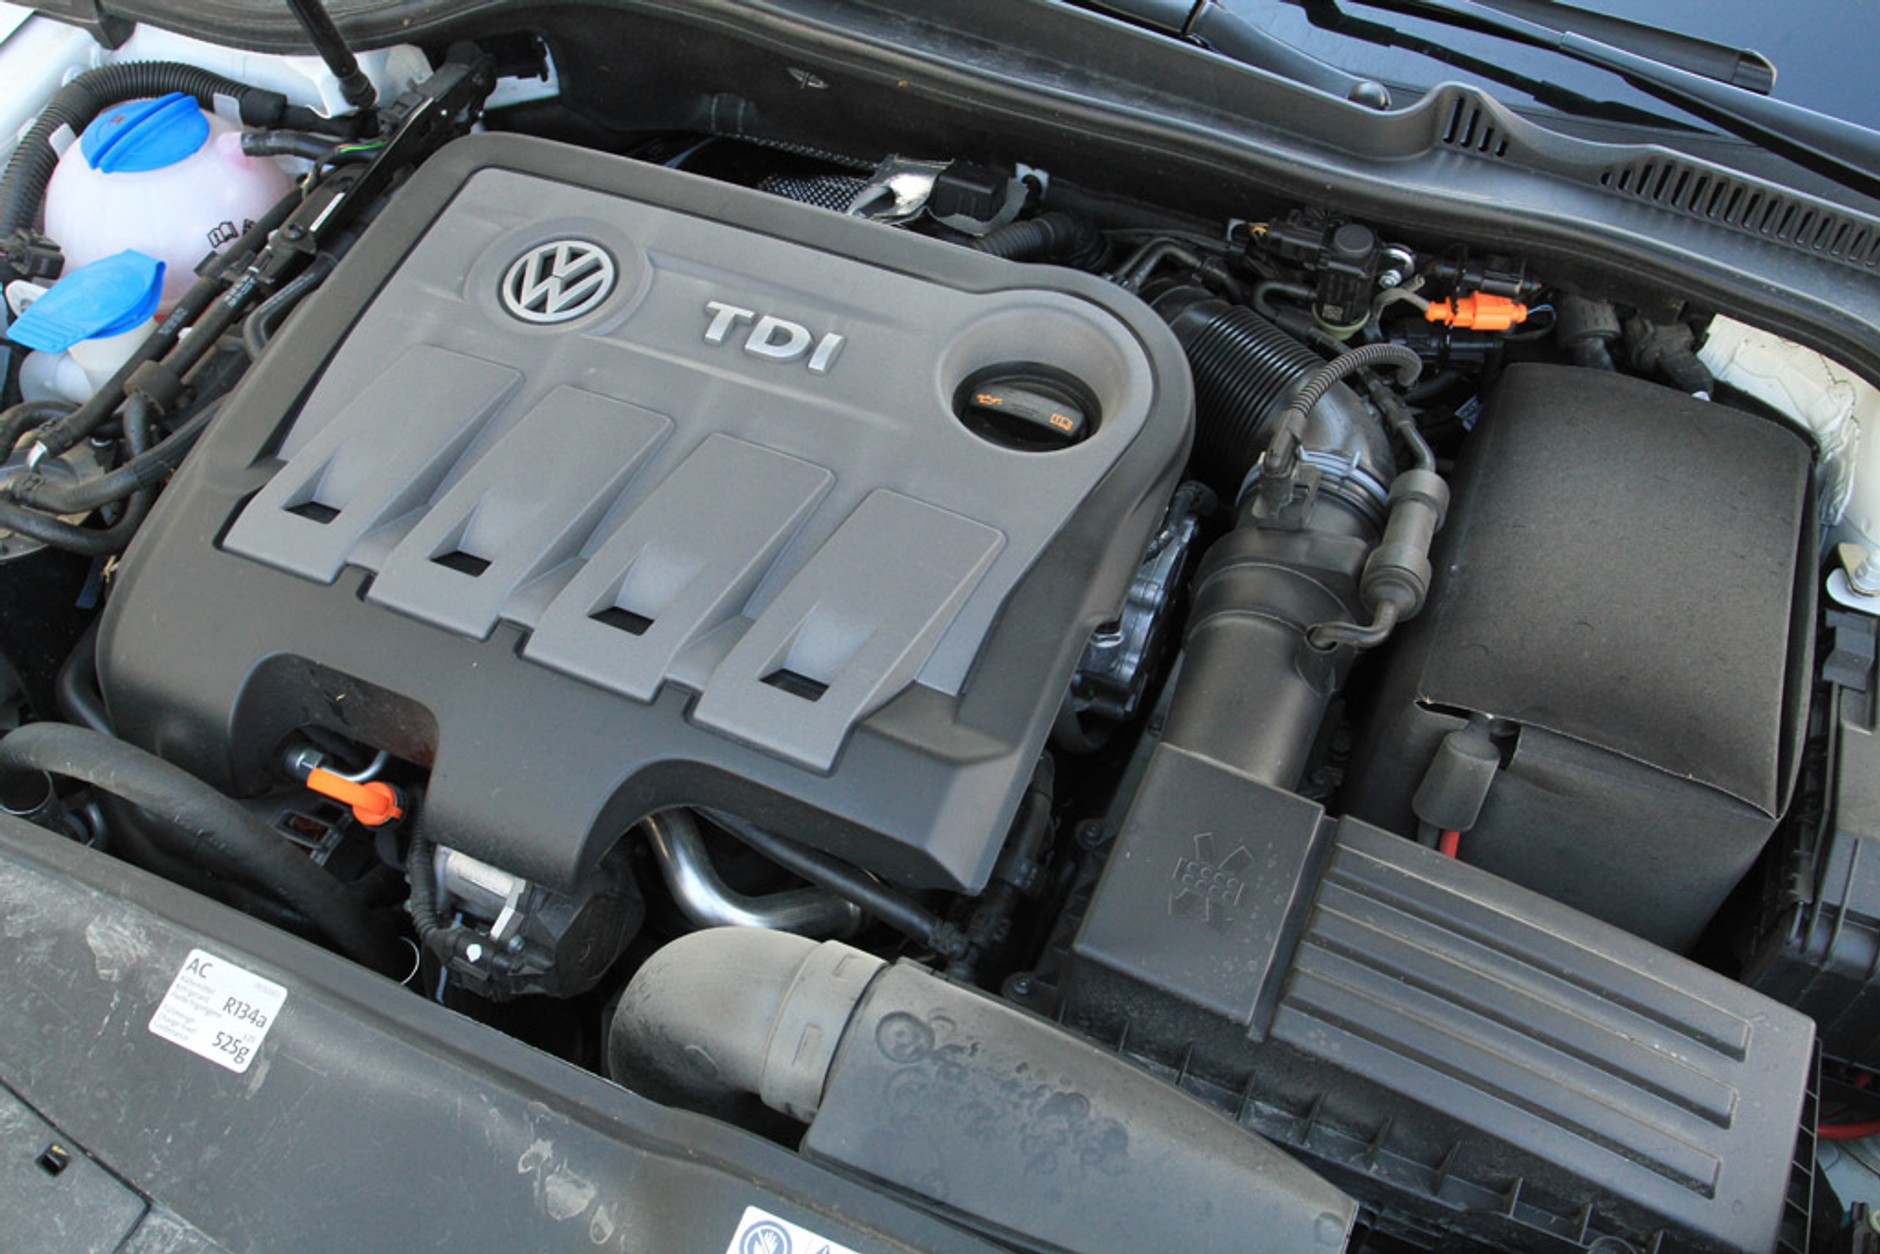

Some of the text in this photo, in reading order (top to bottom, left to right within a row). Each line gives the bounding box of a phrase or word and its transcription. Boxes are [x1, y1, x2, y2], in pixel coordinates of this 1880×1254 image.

[705, 300, 846, 373] TDI
[186, 958, 213, 978] AC
[223, 997, 268, 1028] R134a
[212, 1031, 250, 1064] 525g
